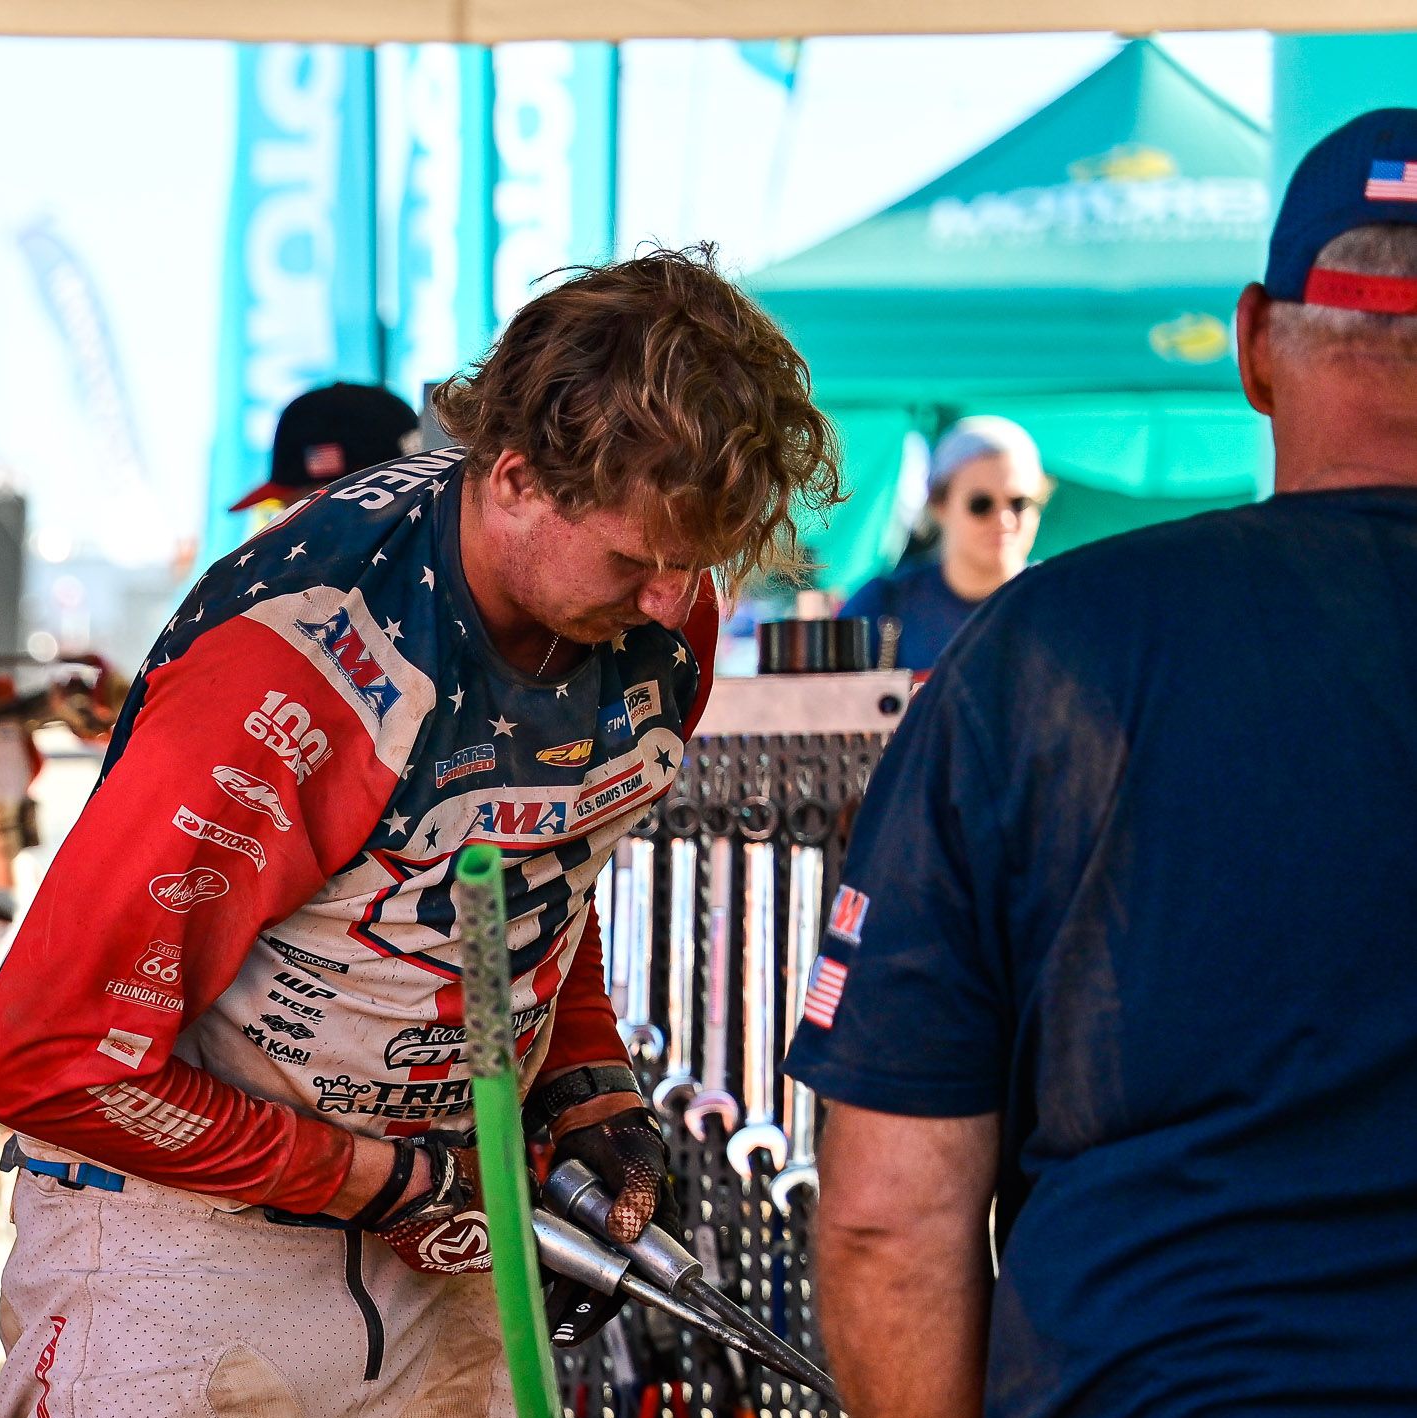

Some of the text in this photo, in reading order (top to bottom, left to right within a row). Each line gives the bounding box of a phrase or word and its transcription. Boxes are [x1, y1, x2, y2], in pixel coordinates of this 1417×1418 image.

[606, 713, 627, 733] FIM
[576, 773, 644, 817] U.S. 6DAYS TEAM
[460, 800, 567, 842] AMA
[200, 823, 265, 865] MOTOREX
[142, 956, 180, 984] 66
[287, 948, 343, 972] MOTOREX
[267, 990, 326, 1019] EXCEL
[369, 1079, 474, 1106] TRA
